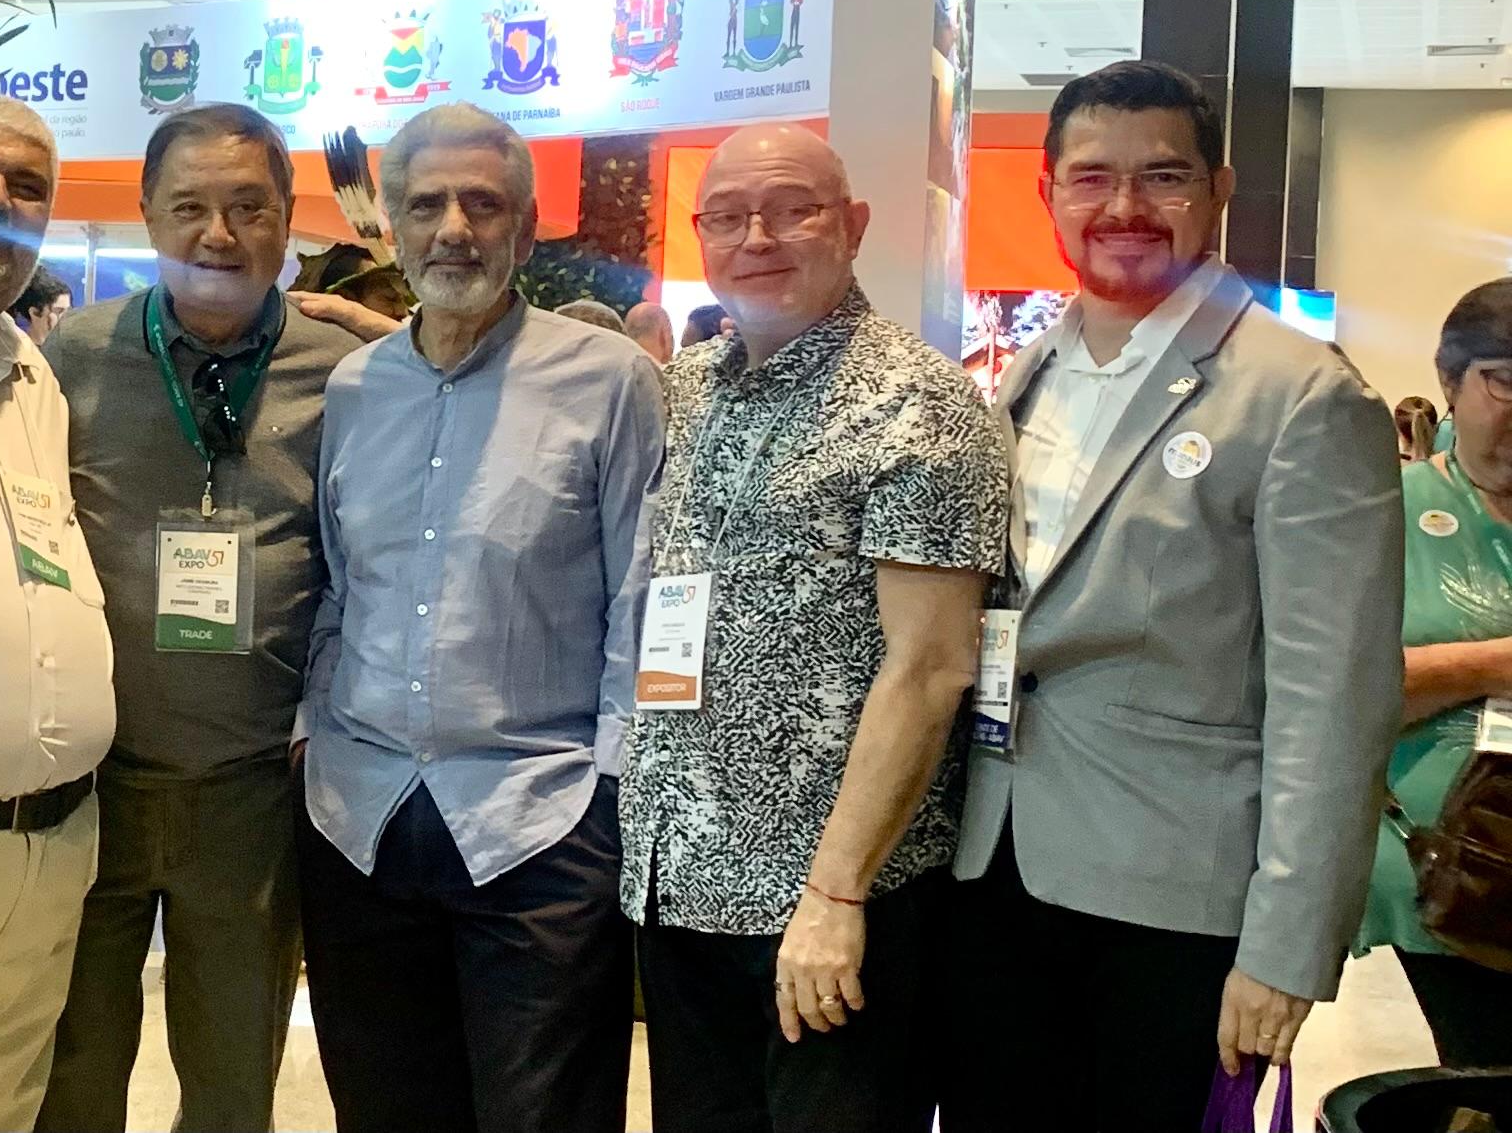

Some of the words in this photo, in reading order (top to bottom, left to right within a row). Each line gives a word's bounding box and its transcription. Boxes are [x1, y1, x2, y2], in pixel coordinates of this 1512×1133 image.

[745, 84, 775, 98] GRANDE
[776, 79, 811, 95] PAULISTA
[512, 110, 522, 121] DE
[178, 560, 205, 569] EXPO
[178, 629, 213, 640] TRADE
